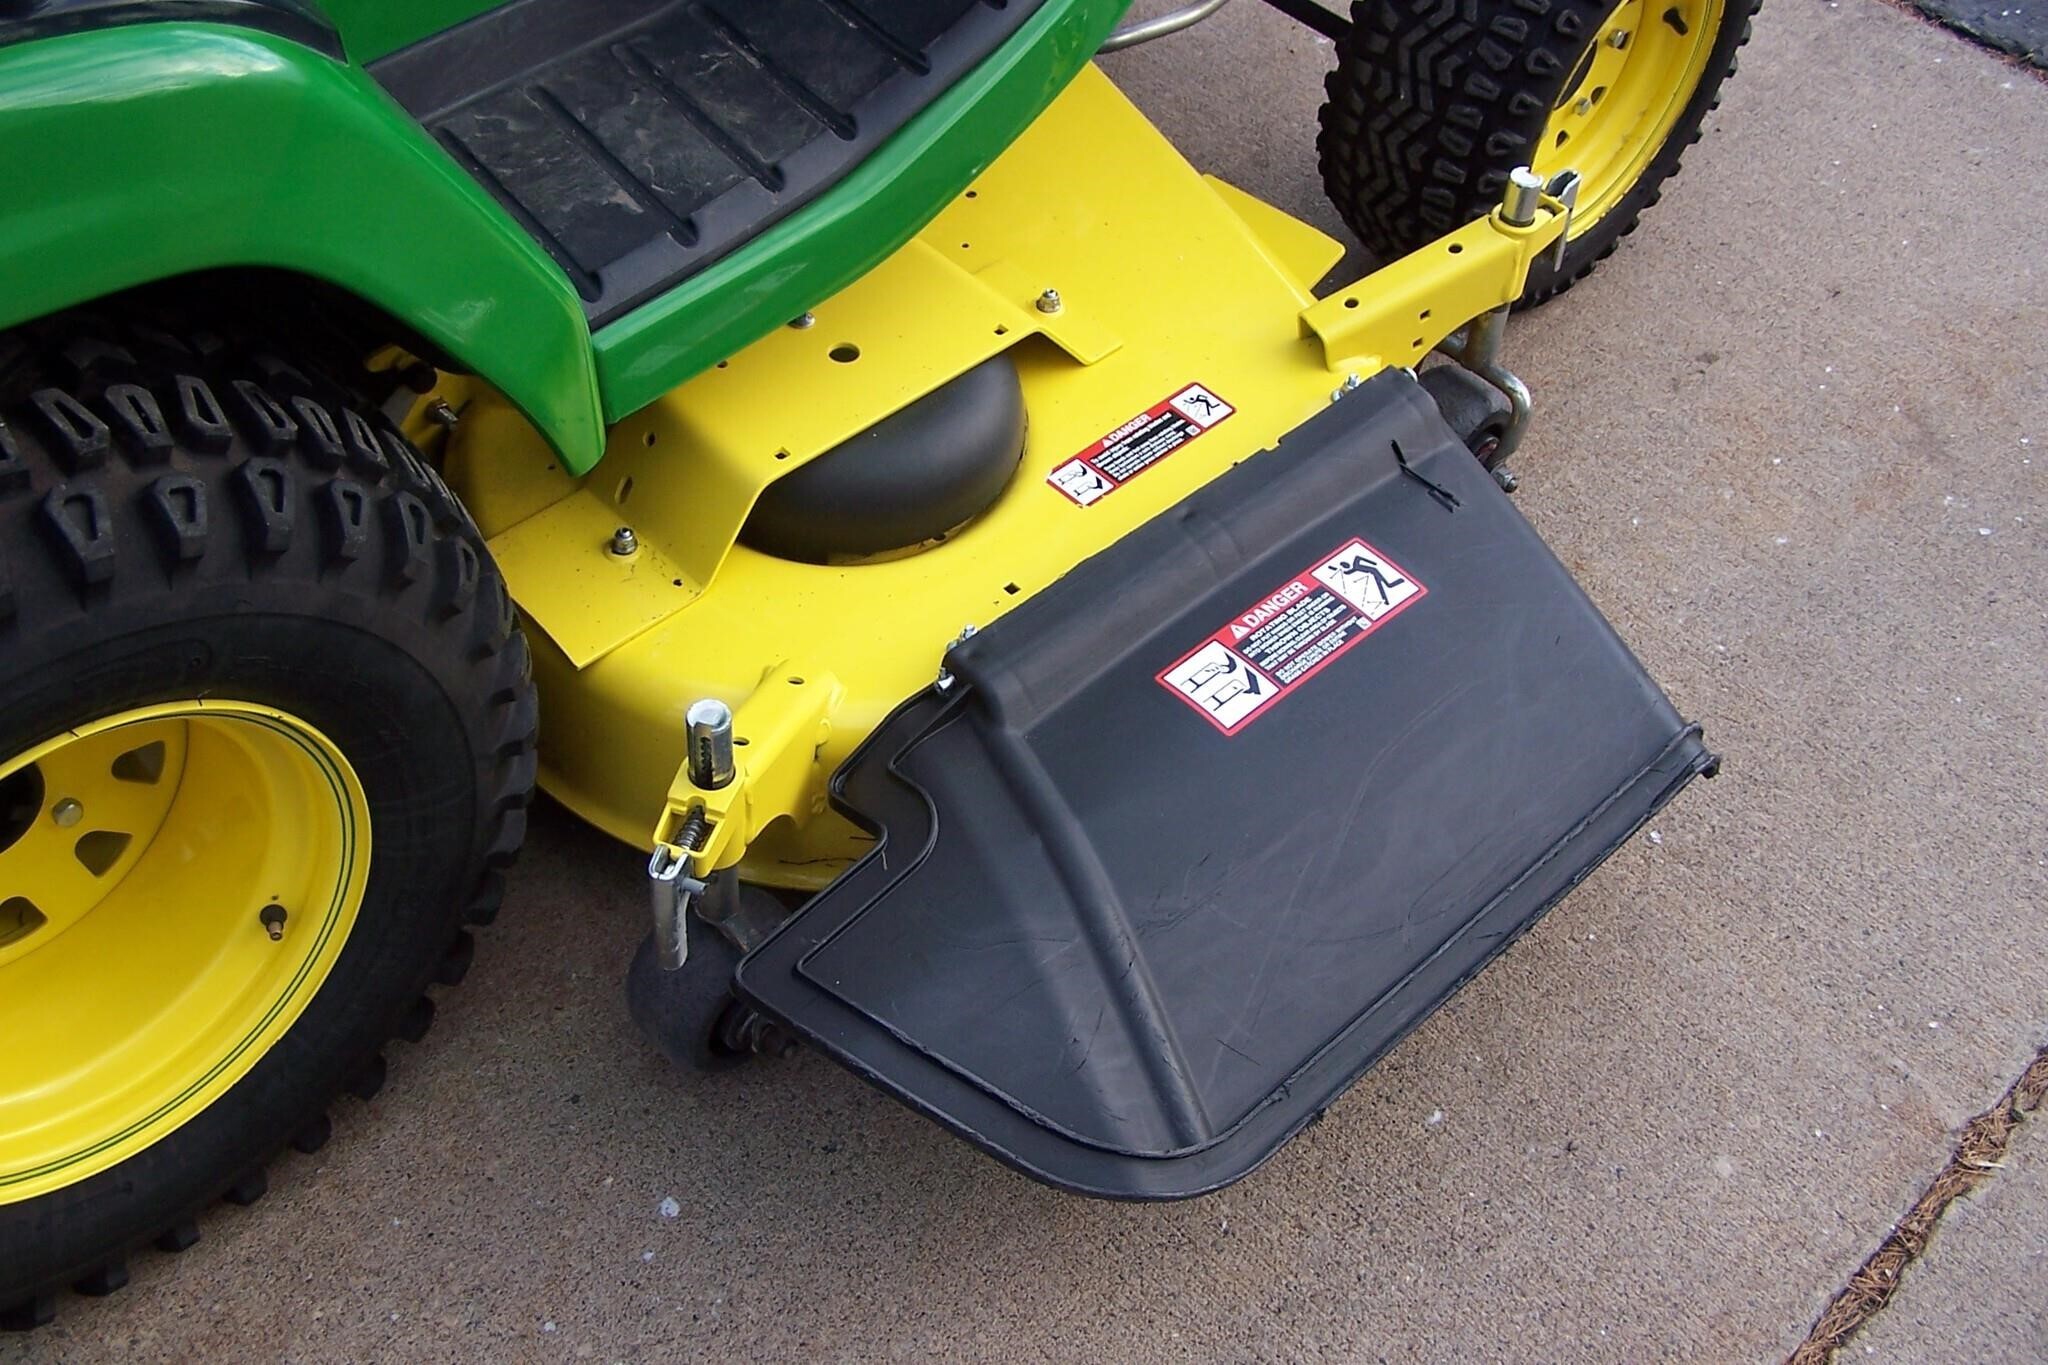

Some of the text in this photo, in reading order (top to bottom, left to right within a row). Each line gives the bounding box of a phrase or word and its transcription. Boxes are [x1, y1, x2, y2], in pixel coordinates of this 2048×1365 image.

[1108, 414, 1152, 442] DANGER
[1240, 579, 1309, 628] DANGER
[1248, 595, 1313, 641] ROTATING BLADE
[1263, 606, 1331, 655] THROWN OBJECTS
